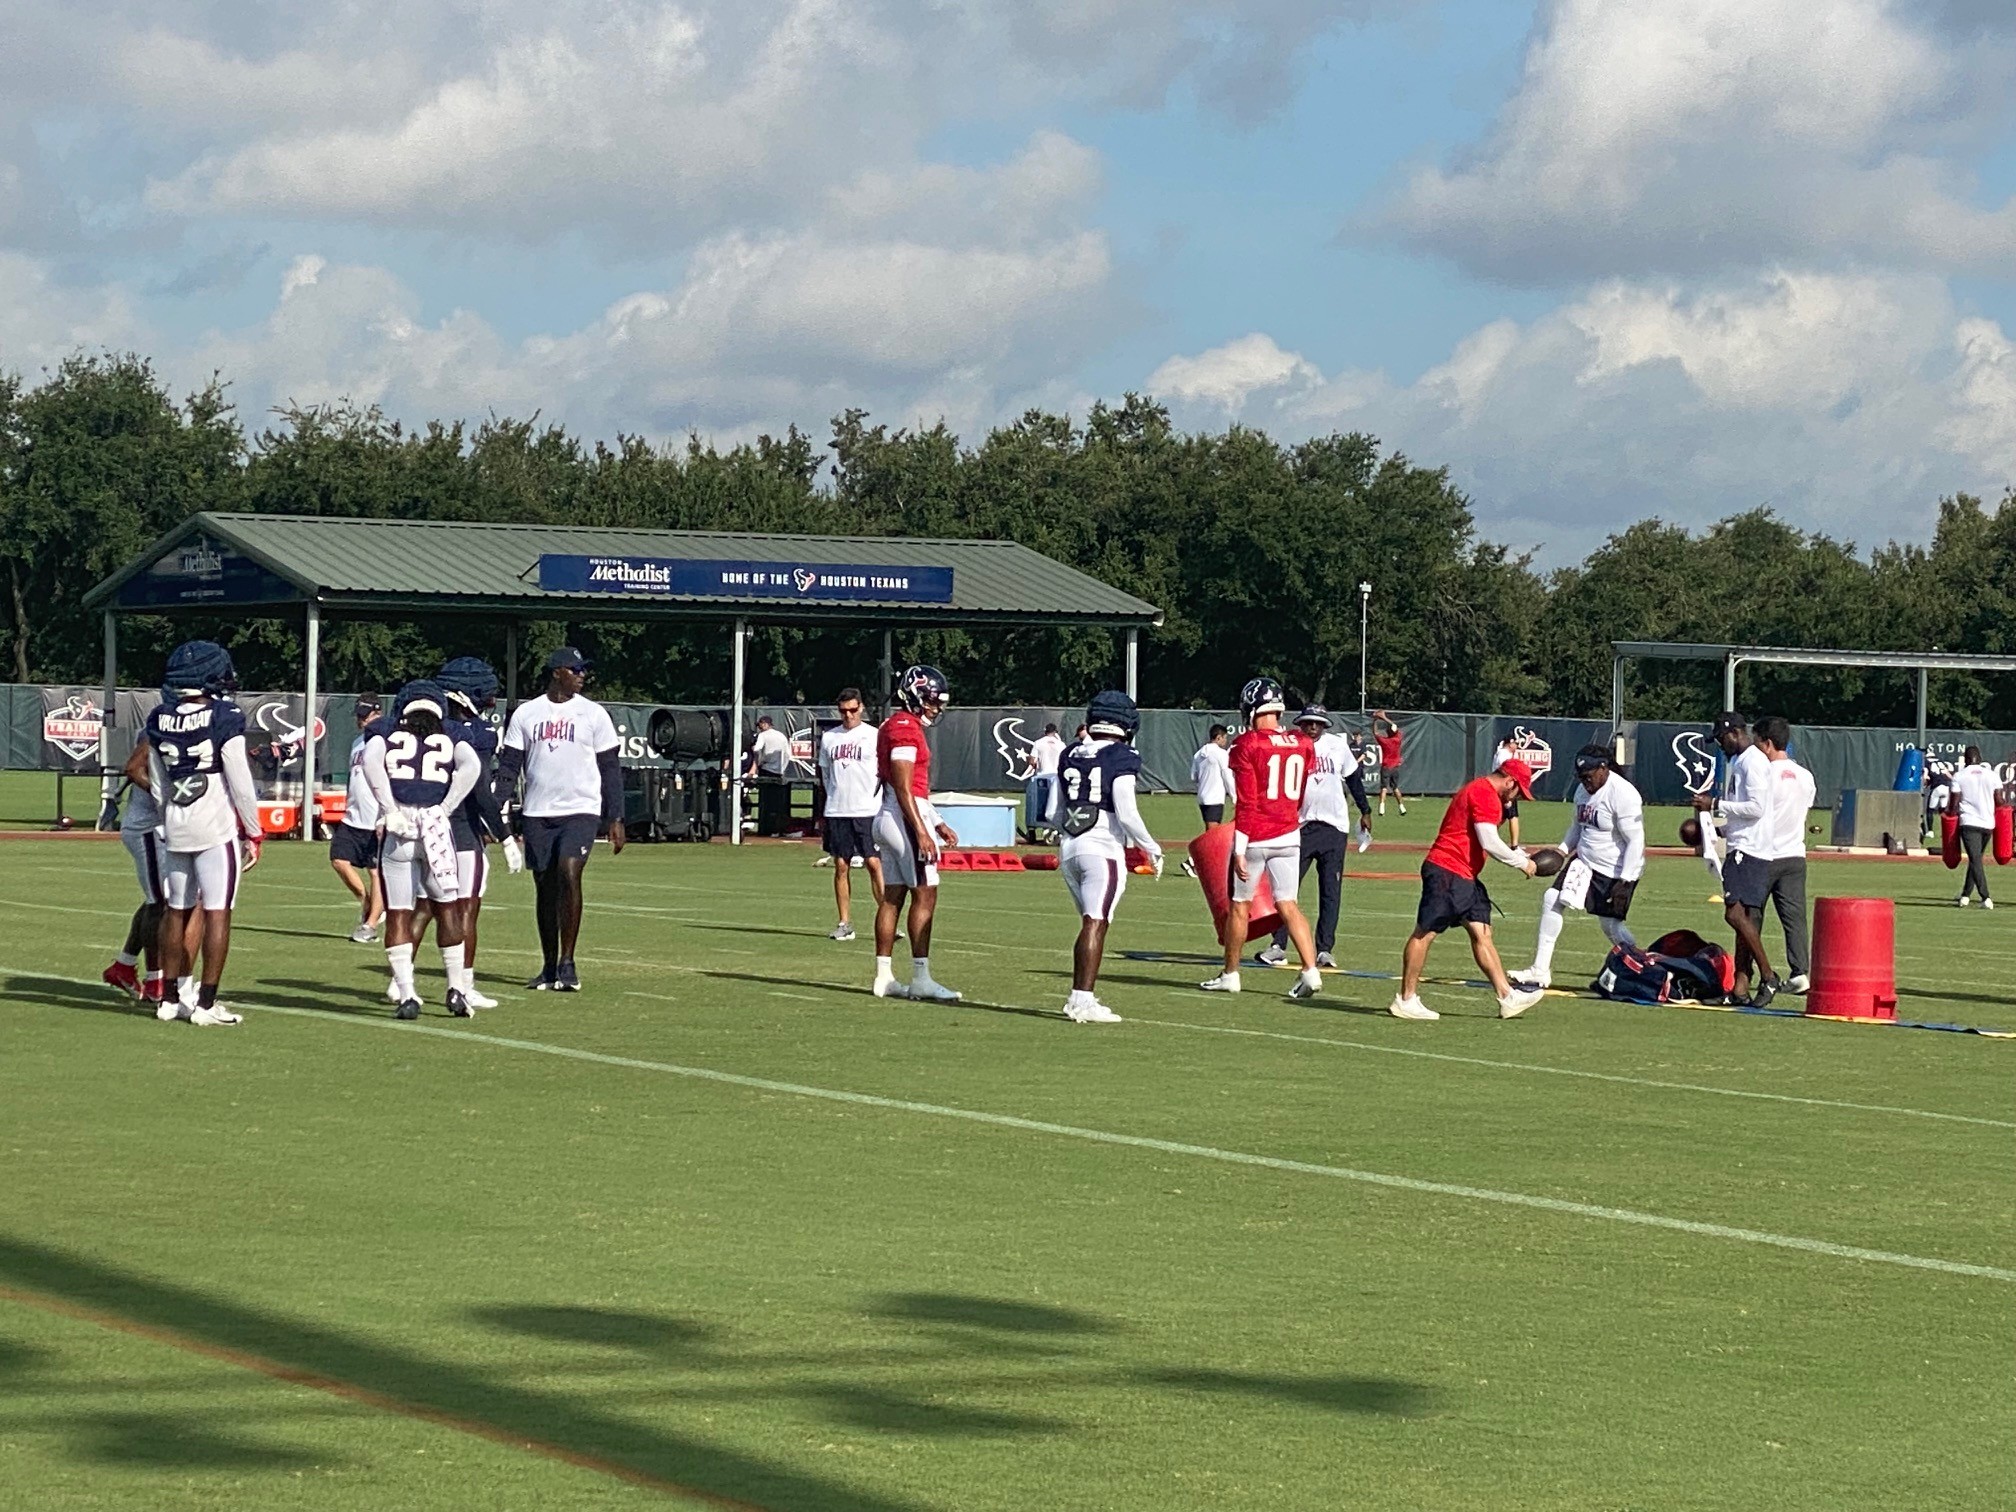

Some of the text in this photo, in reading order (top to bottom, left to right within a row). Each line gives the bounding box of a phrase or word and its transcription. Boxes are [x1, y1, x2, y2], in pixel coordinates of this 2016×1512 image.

[589, 562, 671, 583] Methodist
[722, 572, 909, 589] HOME OF THE HOUSTON TEXANS
[1268, 734, 1299, 747] MILLS
[385, 730, 454, 784] 22
[1063, 766, 1102, 804] 31
[1266, 753, 1305, 801] 10
[270, 808, 285, 826] G
